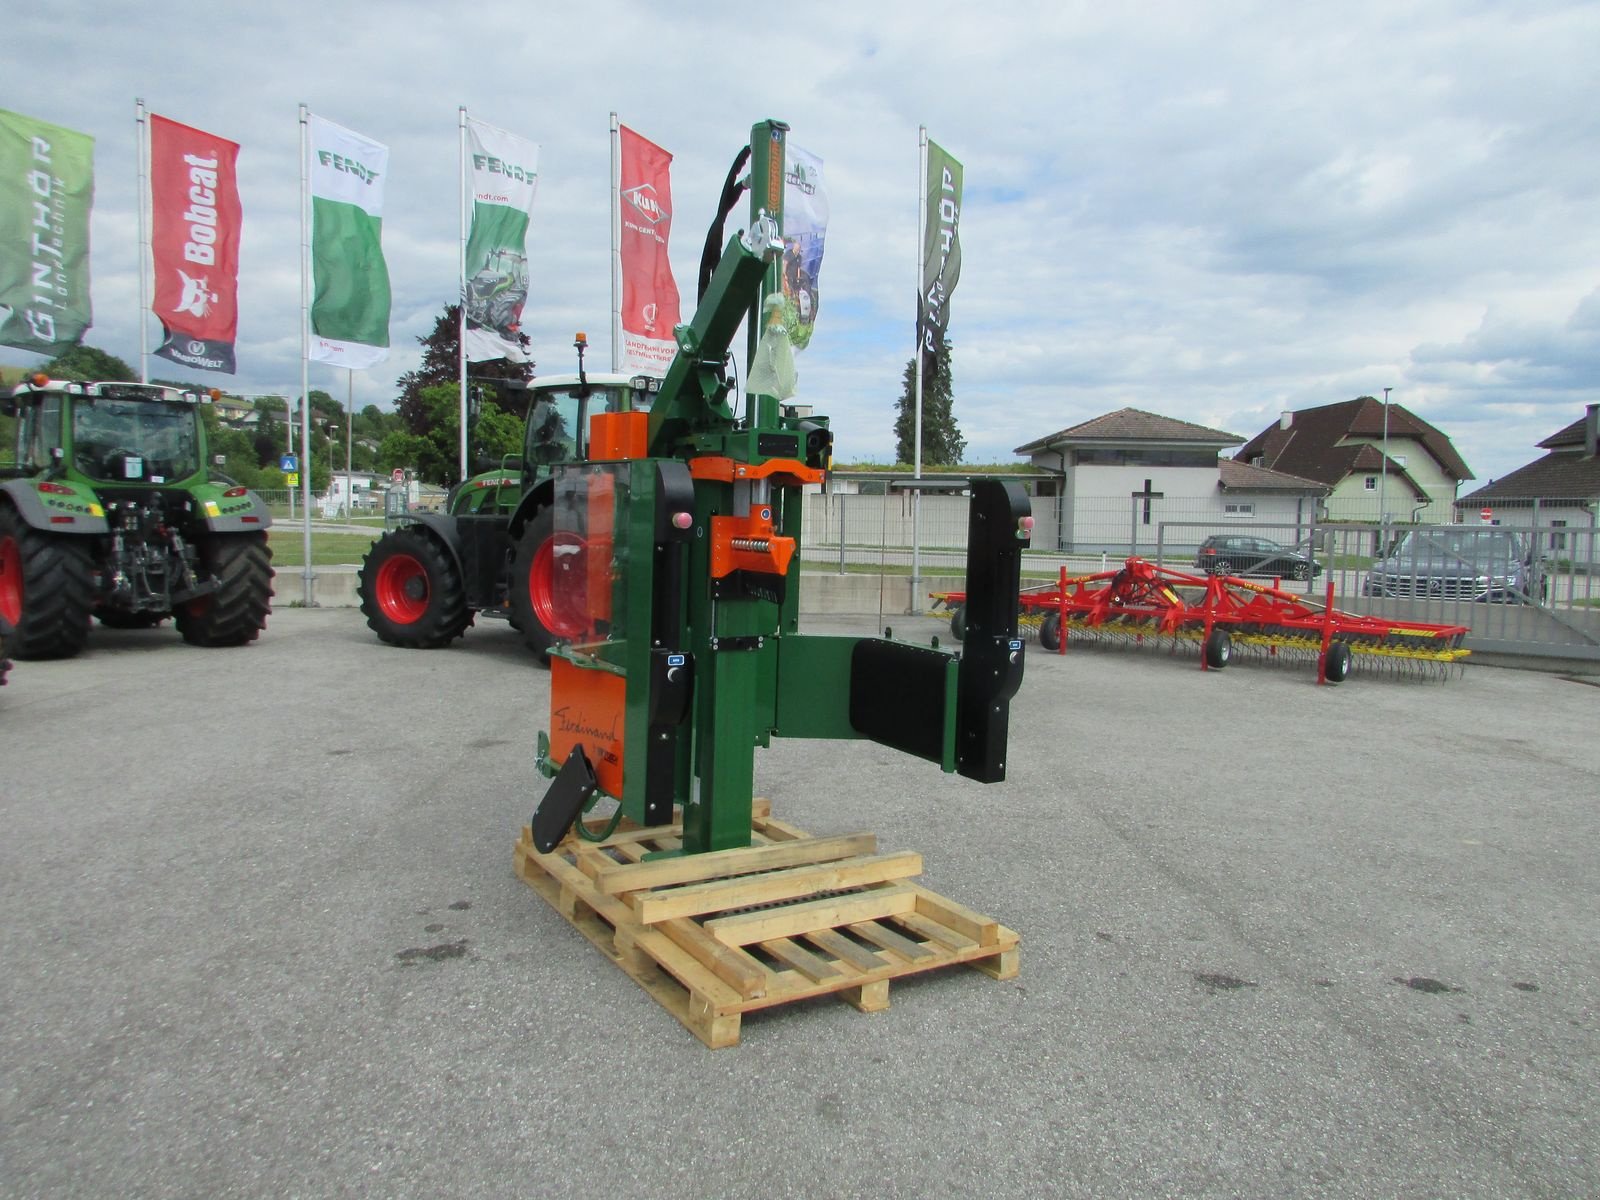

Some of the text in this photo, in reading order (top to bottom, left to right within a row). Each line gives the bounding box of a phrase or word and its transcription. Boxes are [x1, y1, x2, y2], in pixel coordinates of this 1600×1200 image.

[318, 150, 380, 185] FENDT
[473, 154, 537, 185] FENDT
[26, 136, 57, 343] GINTHÖR
[184, 154, 218, 266] Bobcat
